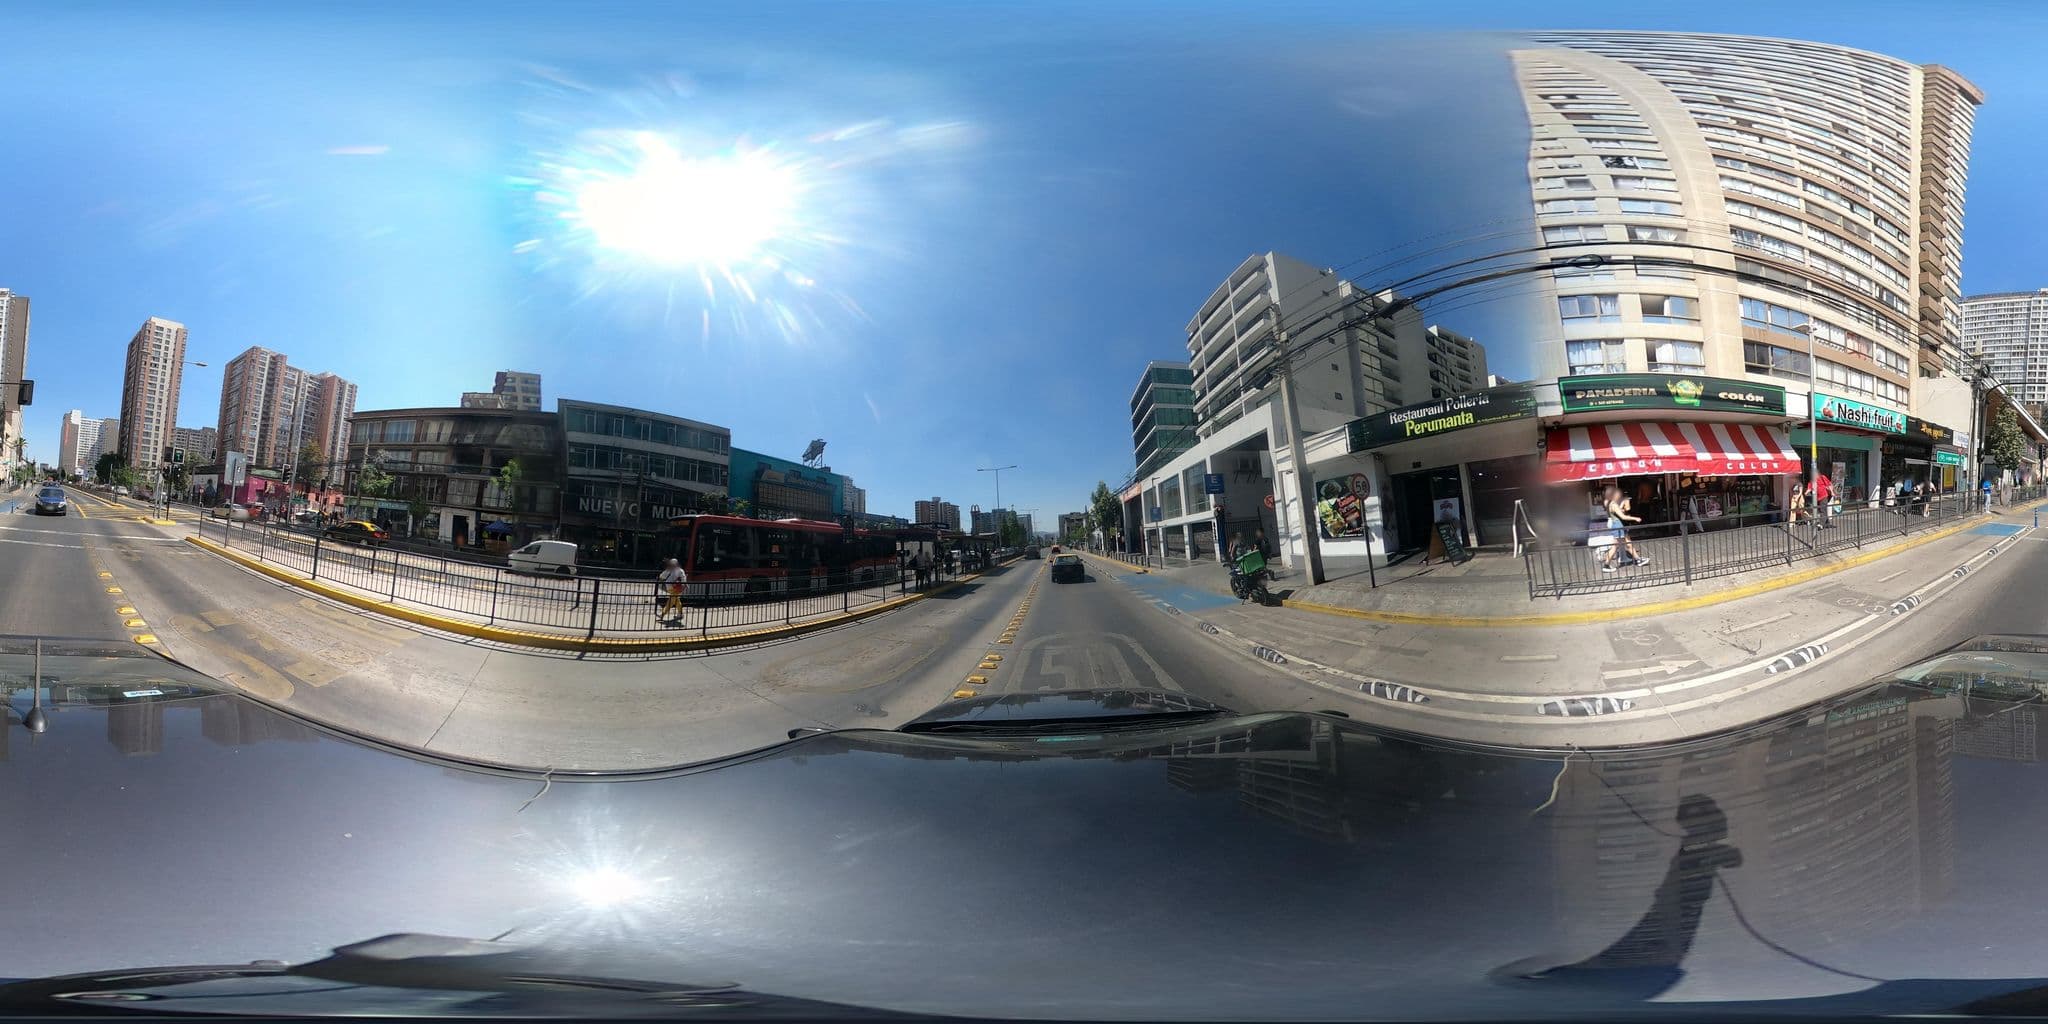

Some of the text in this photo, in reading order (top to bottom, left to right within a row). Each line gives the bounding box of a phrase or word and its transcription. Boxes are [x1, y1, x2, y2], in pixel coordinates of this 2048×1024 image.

[1718, 391, 1765, 403] COLÓN
[1405, 411, 1475, 437] Perumanta
[1837, 402, 1871, 424] Nashi
[1873, 409, 1894, 428] fruit
[1588, 458, 1663, 473] COLON
[1726, 461, 1780, 471] COLON
[578, 497, 641, 518] NUEVO
